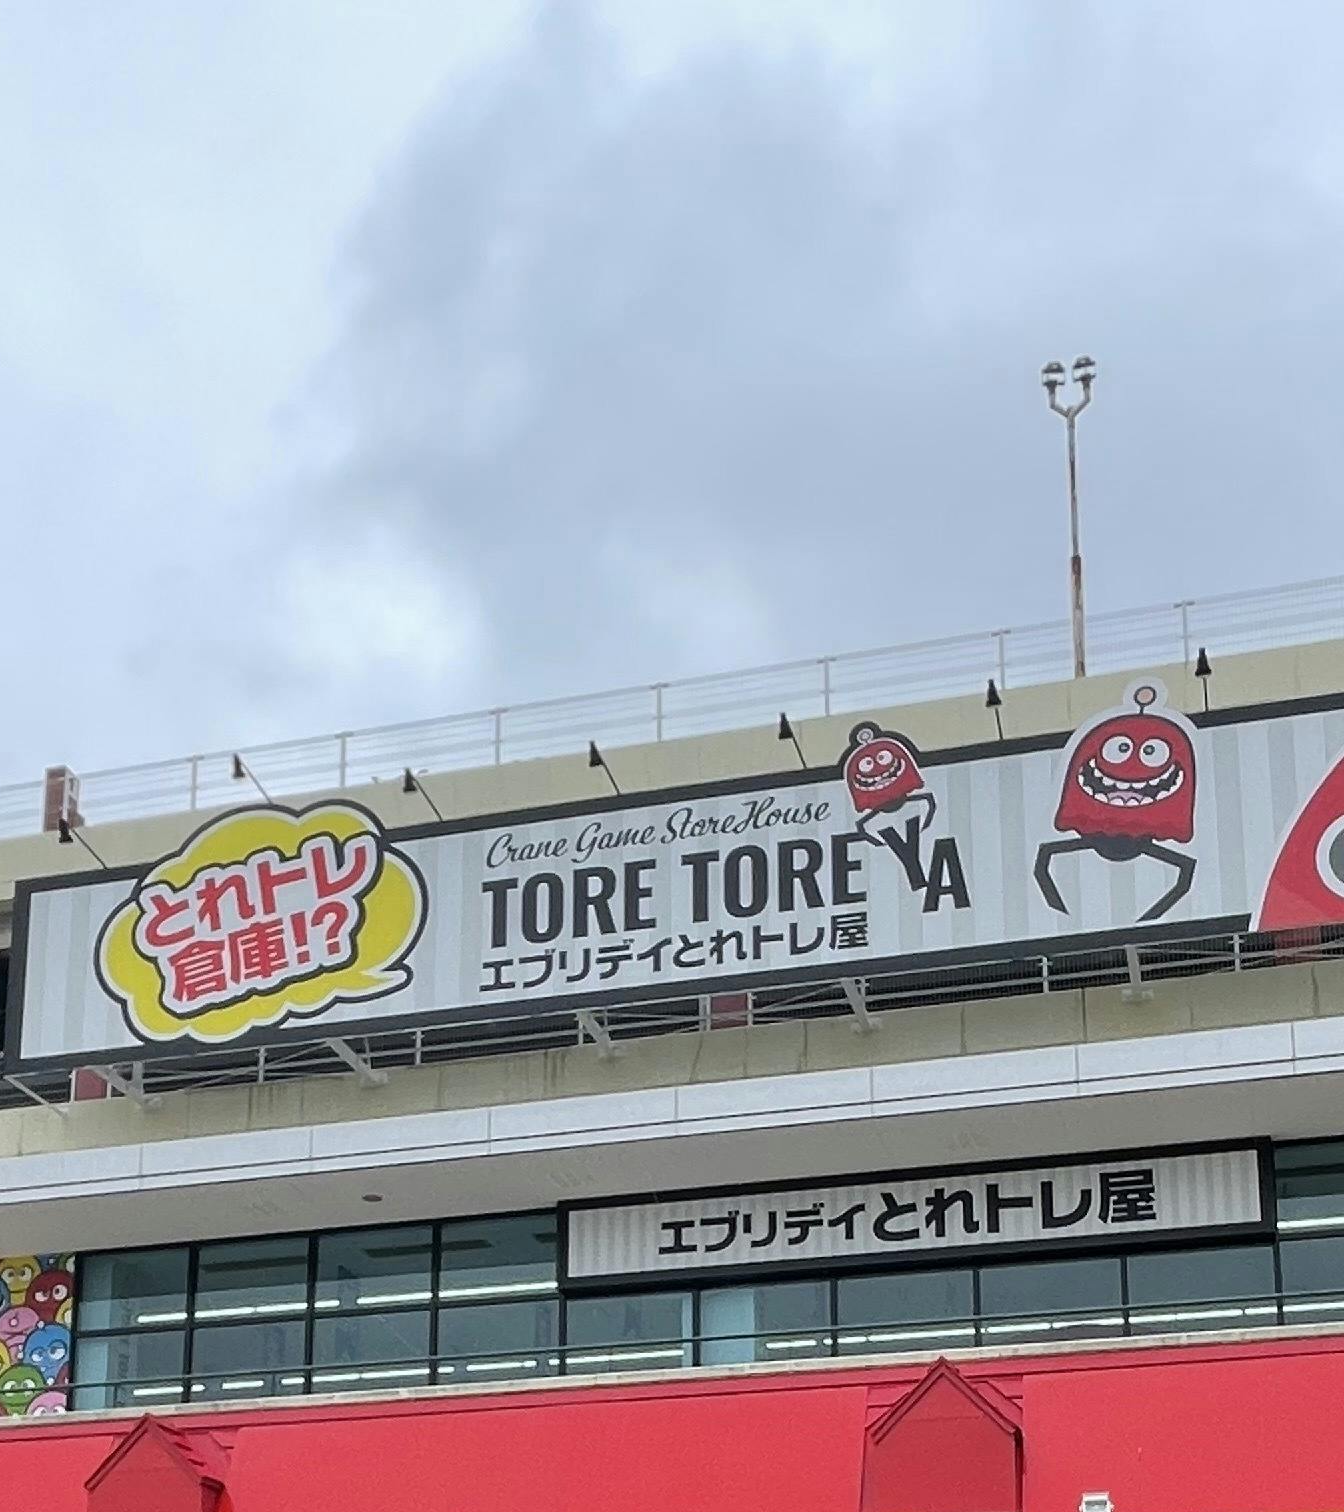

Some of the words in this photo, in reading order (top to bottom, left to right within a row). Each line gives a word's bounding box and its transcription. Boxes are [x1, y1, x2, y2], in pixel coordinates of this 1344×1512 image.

[144, 844, 368, 948] とれトレ
[481, 858, 657, 949] TORE
[681, 831, 868, 924] TORE
[485, 832, 567, 869] Crane
[571, 820, 656, 864] Game
